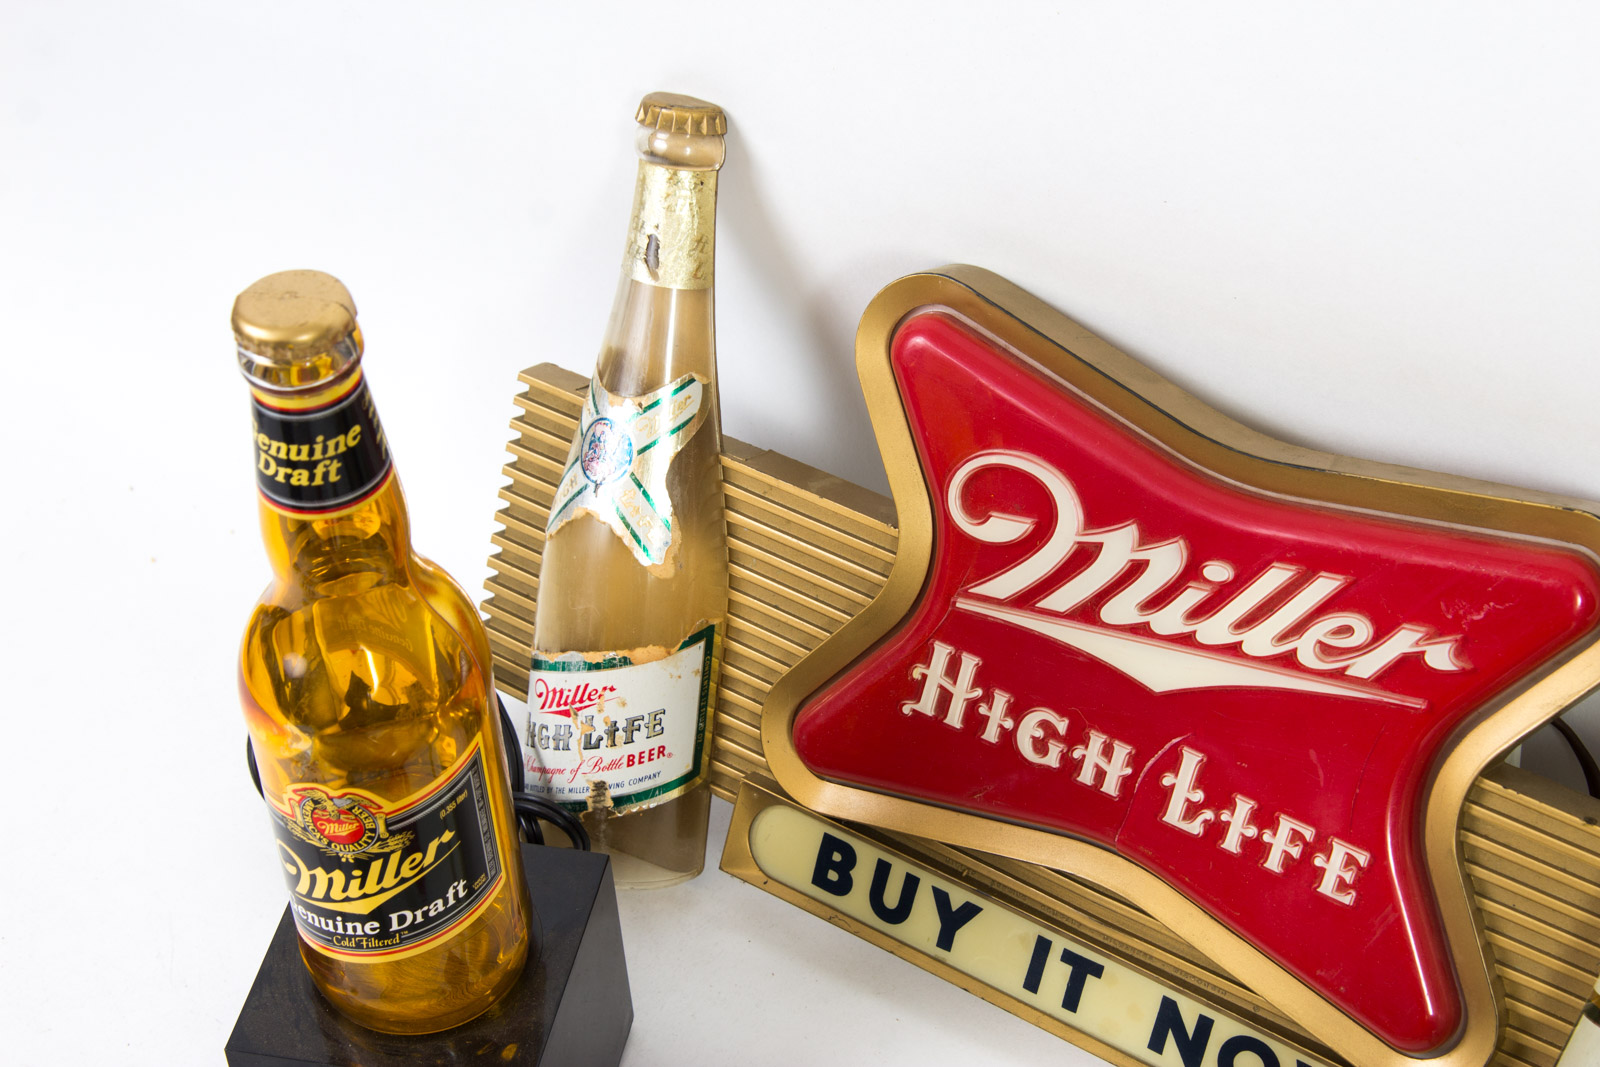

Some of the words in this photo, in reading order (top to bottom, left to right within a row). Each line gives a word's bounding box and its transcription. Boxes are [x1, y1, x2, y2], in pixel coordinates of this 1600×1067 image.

[258, 450, 342, 486] Draft
[946, 449, 1473, 682] Miller
[556, 787, 565, 795] THE
[568, 786, 590, 795] MILLER
[628, 770, 662, 787] COMPANY
[567, 759, 585, 784] of
[582, 755, 625, 775] Bottle
[902, 639, 1133, 800] HIGH
[1161, 744, 1370, 907] LIFE
[316, 820, 360, 837] Miller
[351, 806, 376, 830] BEER
[330, 829, 376, 853] QUALITY
[276, 828, 456, 902] Miller
[389, 879, 467, 932] Draft
[333, 935, 356, 948] Cold
[811, 832, 983, 952] BUY
[1022, 933, 1104, 1014] IT
[1147, 995, 1314, 1067] NO
